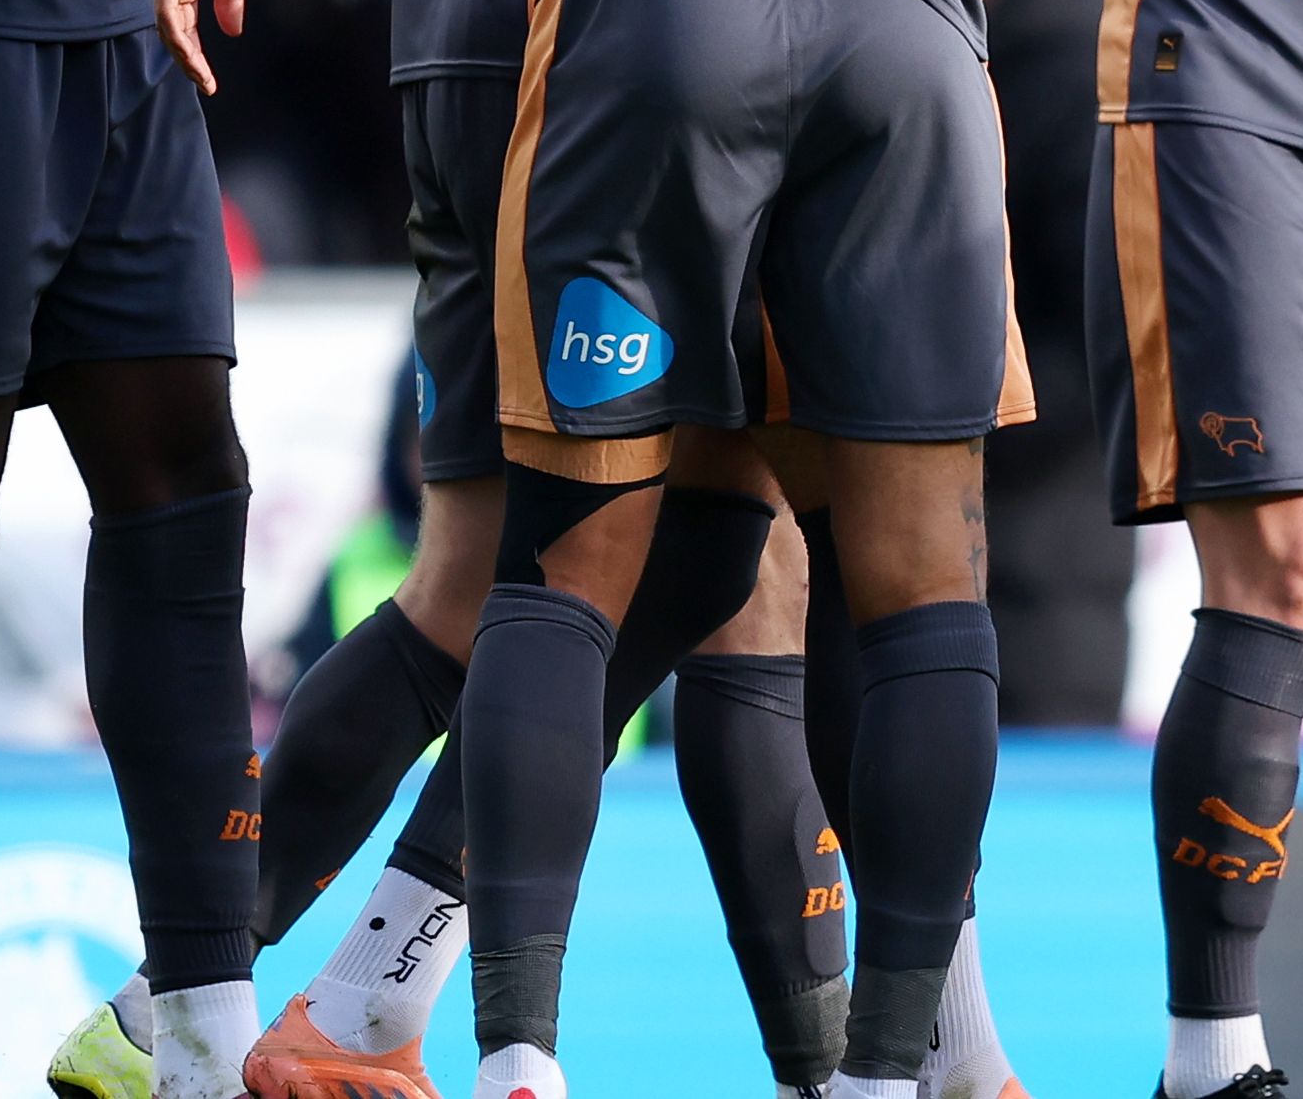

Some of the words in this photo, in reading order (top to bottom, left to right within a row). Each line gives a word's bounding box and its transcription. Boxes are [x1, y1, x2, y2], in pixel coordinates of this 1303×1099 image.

[561, 320, 650, 376] hsg
[219, 809, 262, 841] DC
[1172, 837, 1288, 884] DCF
[802, 881, 846, 917] DC
